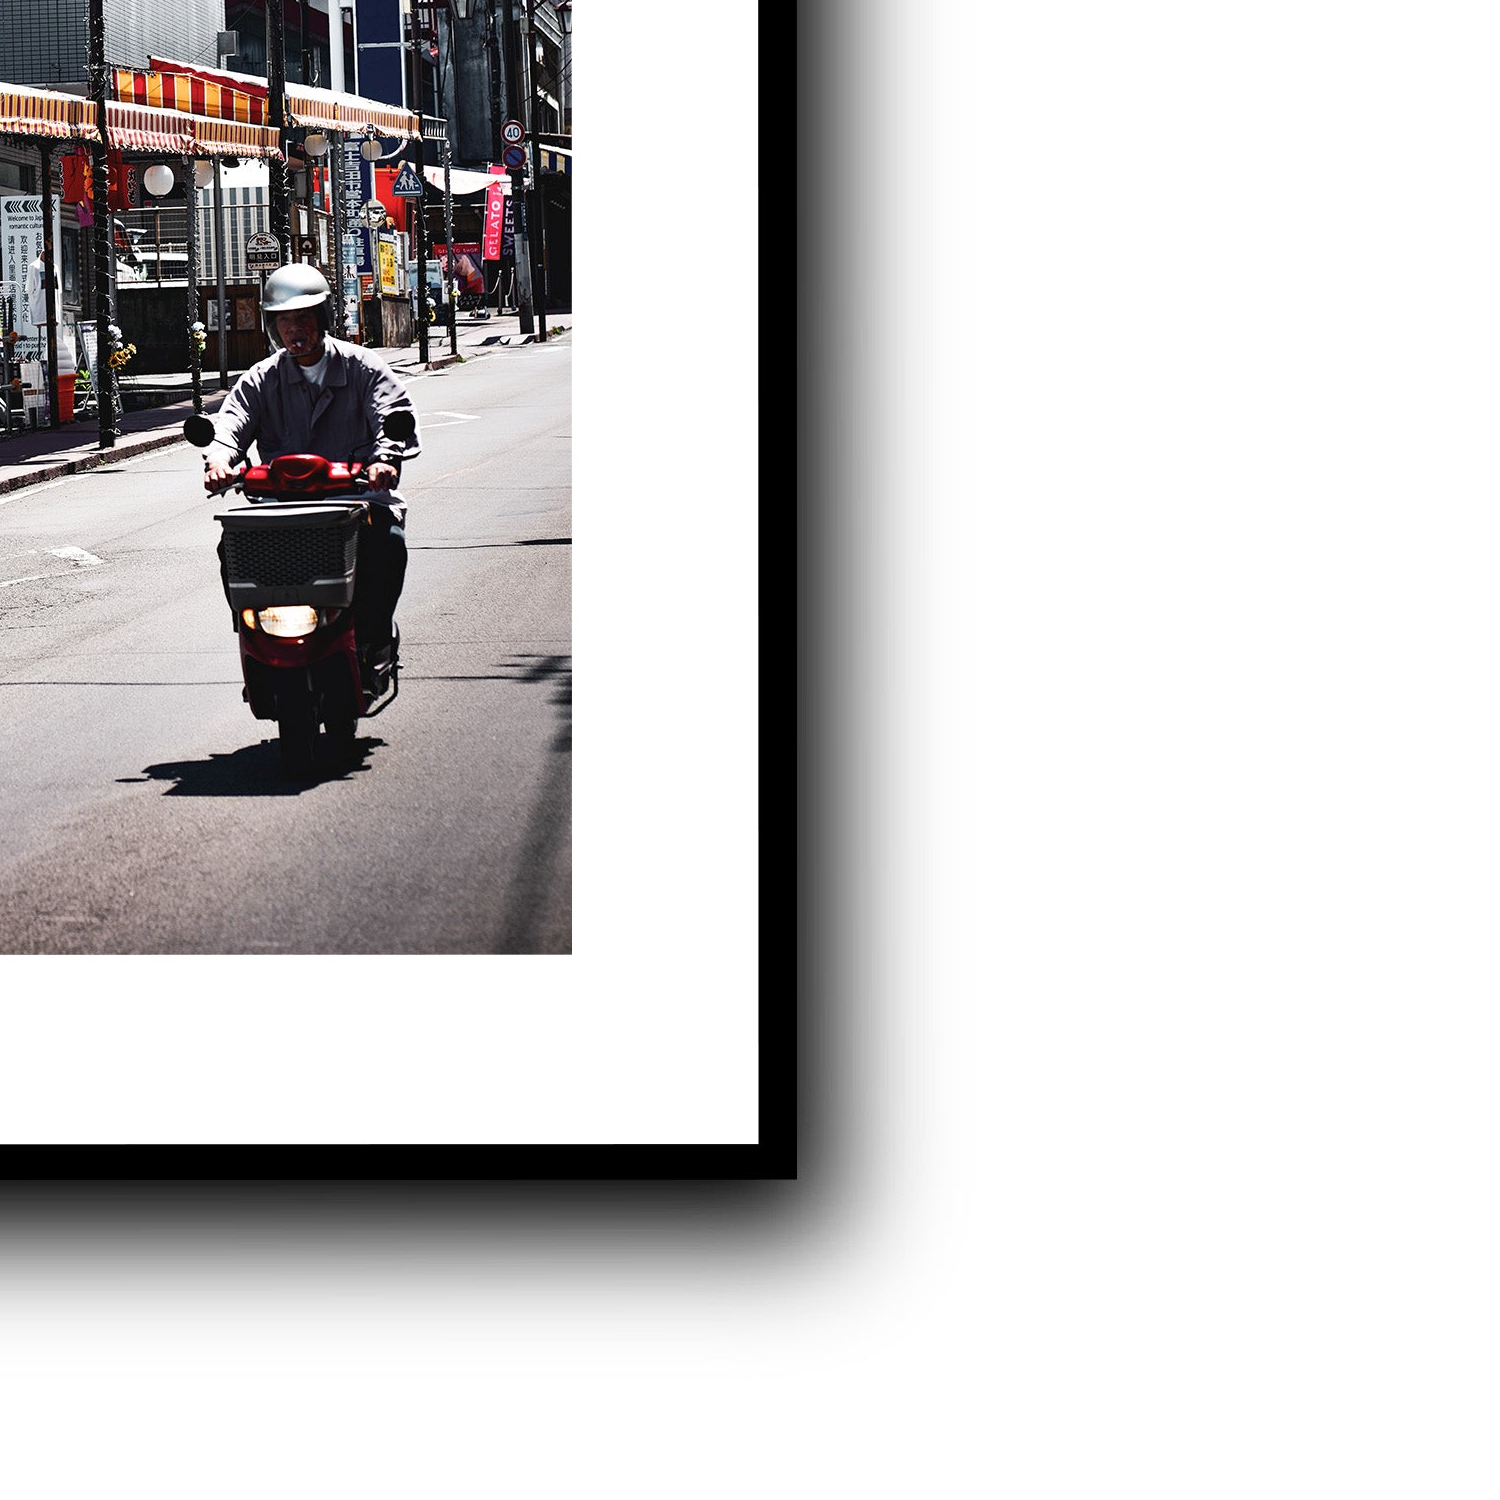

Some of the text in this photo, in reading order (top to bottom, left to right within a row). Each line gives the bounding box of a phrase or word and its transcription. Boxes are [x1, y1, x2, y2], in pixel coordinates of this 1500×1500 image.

[506, 127, 520, 139] 40
[7, 213, 28, 222] Welcome
[488, 200, 501, 257] GELATO
[503, 199, 516, 257] SWEETS
